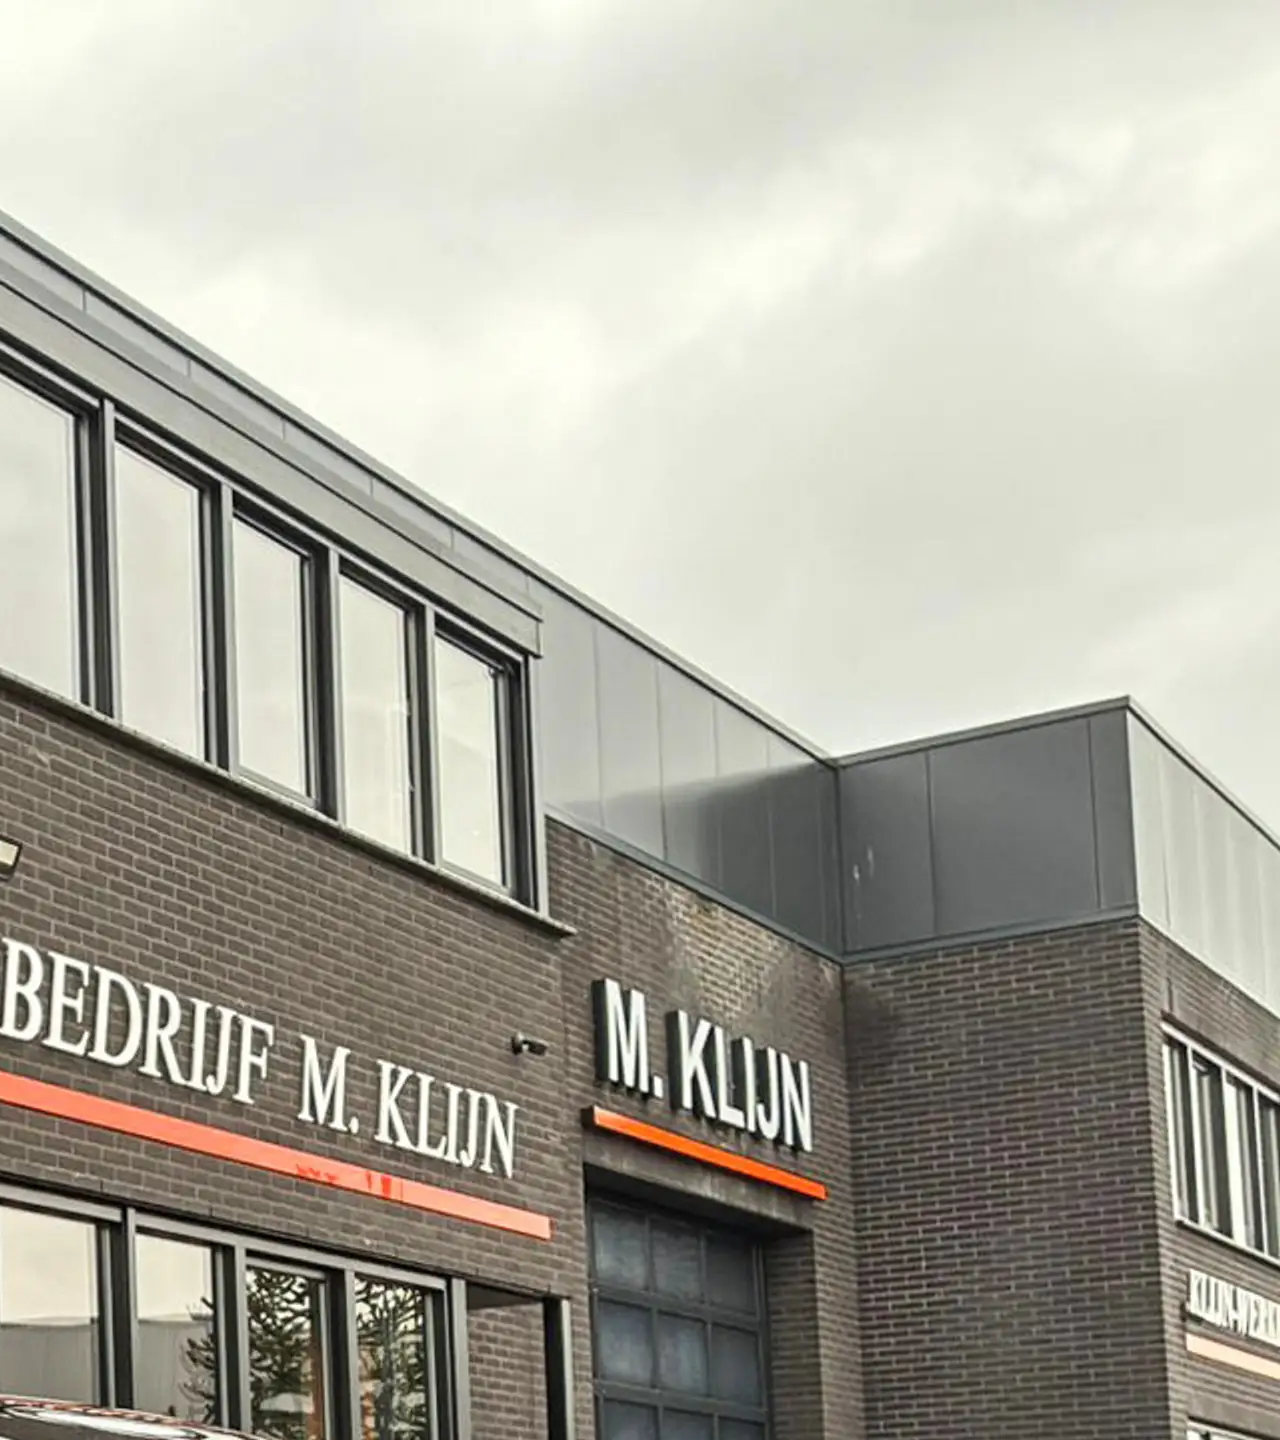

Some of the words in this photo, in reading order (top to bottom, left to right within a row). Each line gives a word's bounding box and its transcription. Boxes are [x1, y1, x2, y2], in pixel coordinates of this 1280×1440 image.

[297, 1034, 360, 1135] M.
[374, 1059, 519, 1179] KLIJN
[602, 977, 663, 1099] M.
[675, 1009, 813, 1152] KLIJN
[1188, 1268, 1280, 1348] KLIJN-WERK
